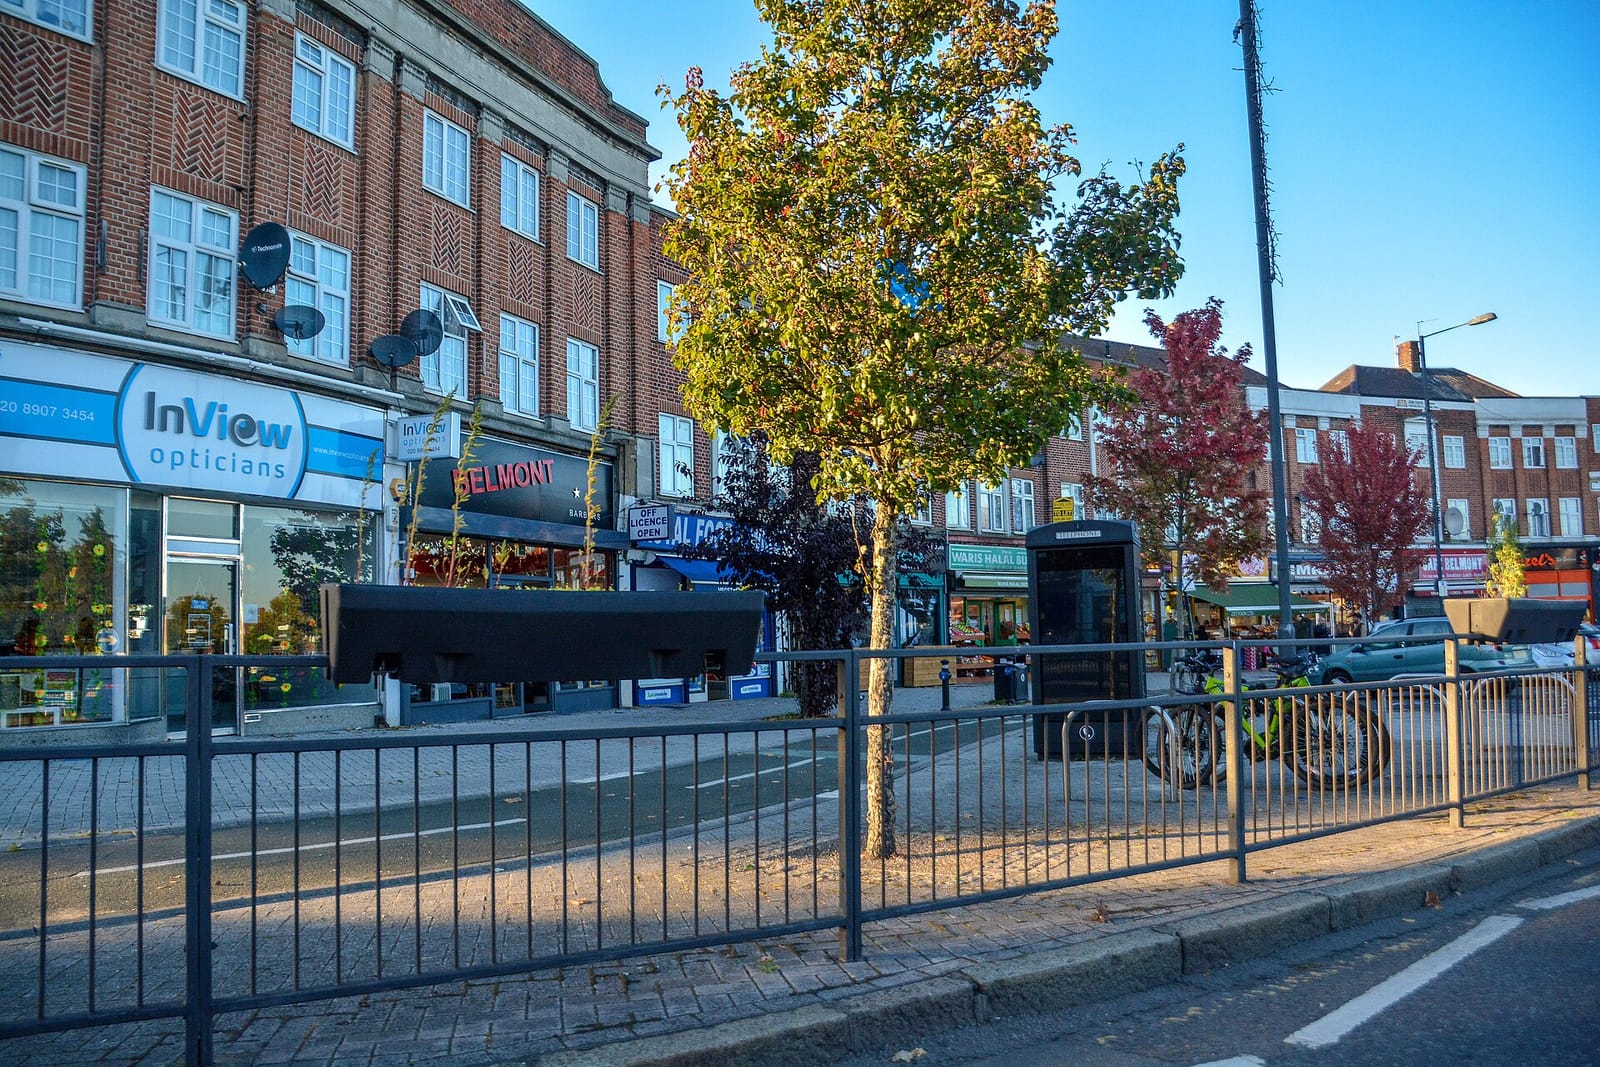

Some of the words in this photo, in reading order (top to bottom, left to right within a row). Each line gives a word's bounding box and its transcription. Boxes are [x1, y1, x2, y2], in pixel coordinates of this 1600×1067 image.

[22, 403, 57, 417] 8907
[62, 408, 95, 421] 3454
[144, 391, 293, 449] InView
[150, 447, 286, 479] opticians
[452, 459, 554, 495] BELMONT
[569, 508, 601, 521] BARBRS
[641, 508, 657, 517] OFF
[630, 516, 667, 527] LICENCE
[637, 528, 661, 537] OPEN
[951, 551, 983, 563] WARIS
[985, 555, 1014, 565] HALAL
[1445, 557, 1483, 570] BELMONT
